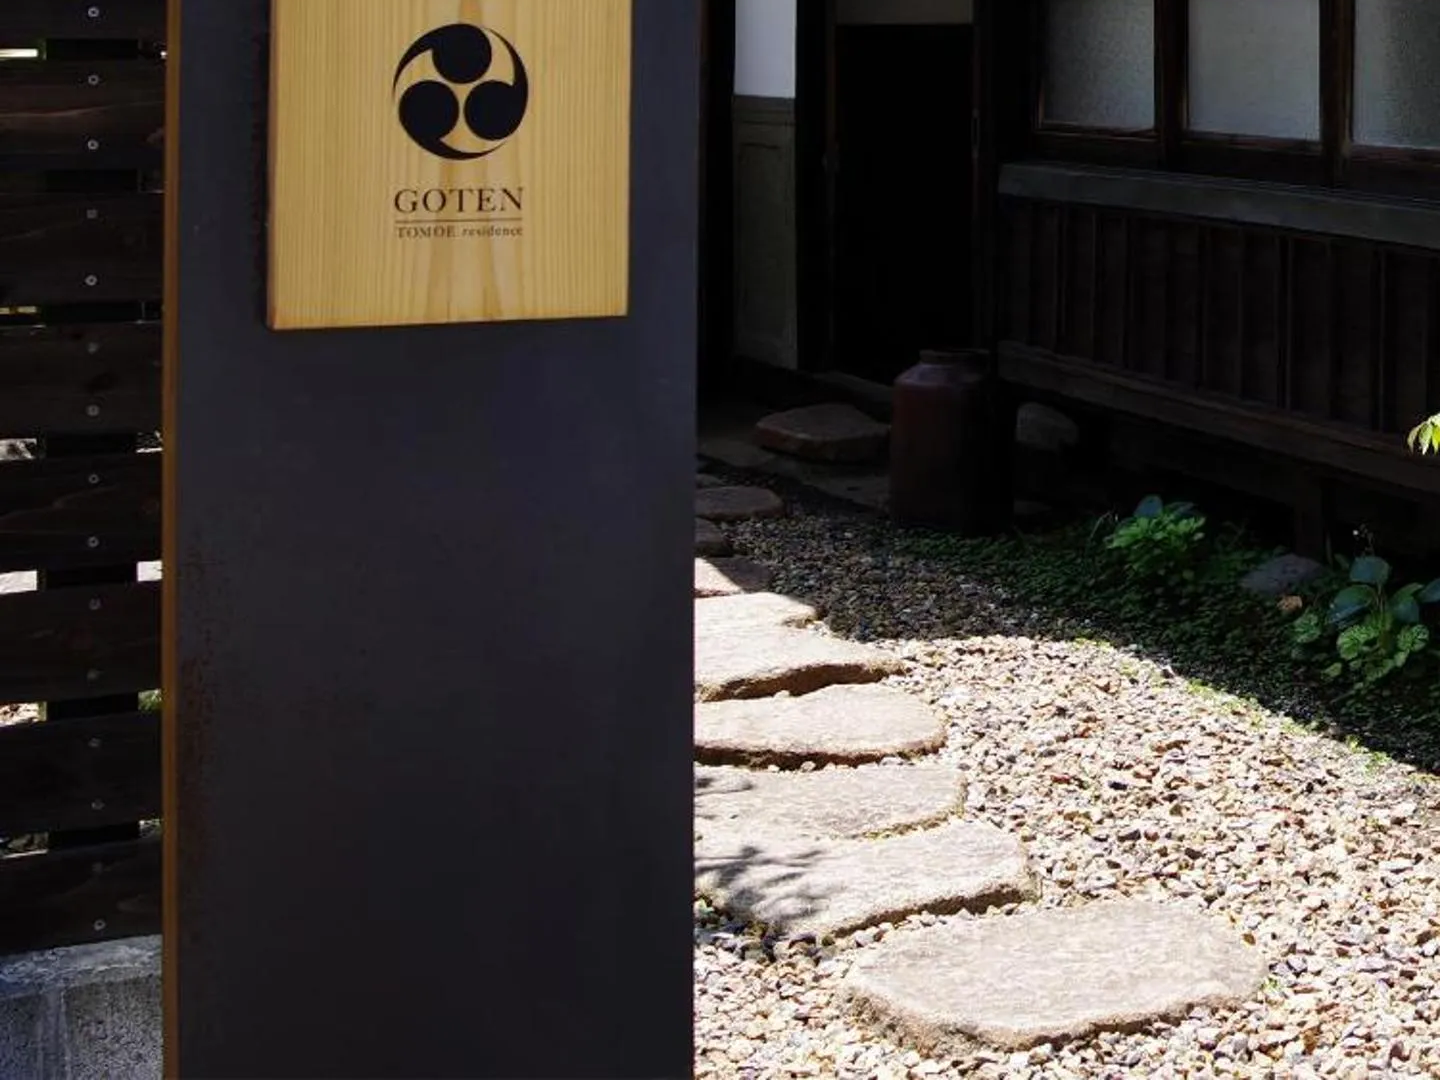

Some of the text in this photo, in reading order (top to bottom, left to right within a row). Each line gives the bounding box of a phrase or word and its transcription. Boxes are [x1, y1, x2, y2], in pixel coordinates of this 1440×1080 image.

[394, 187, 524, 214] GOTEN
[396, 224, 524, 239] TOMOE residence
